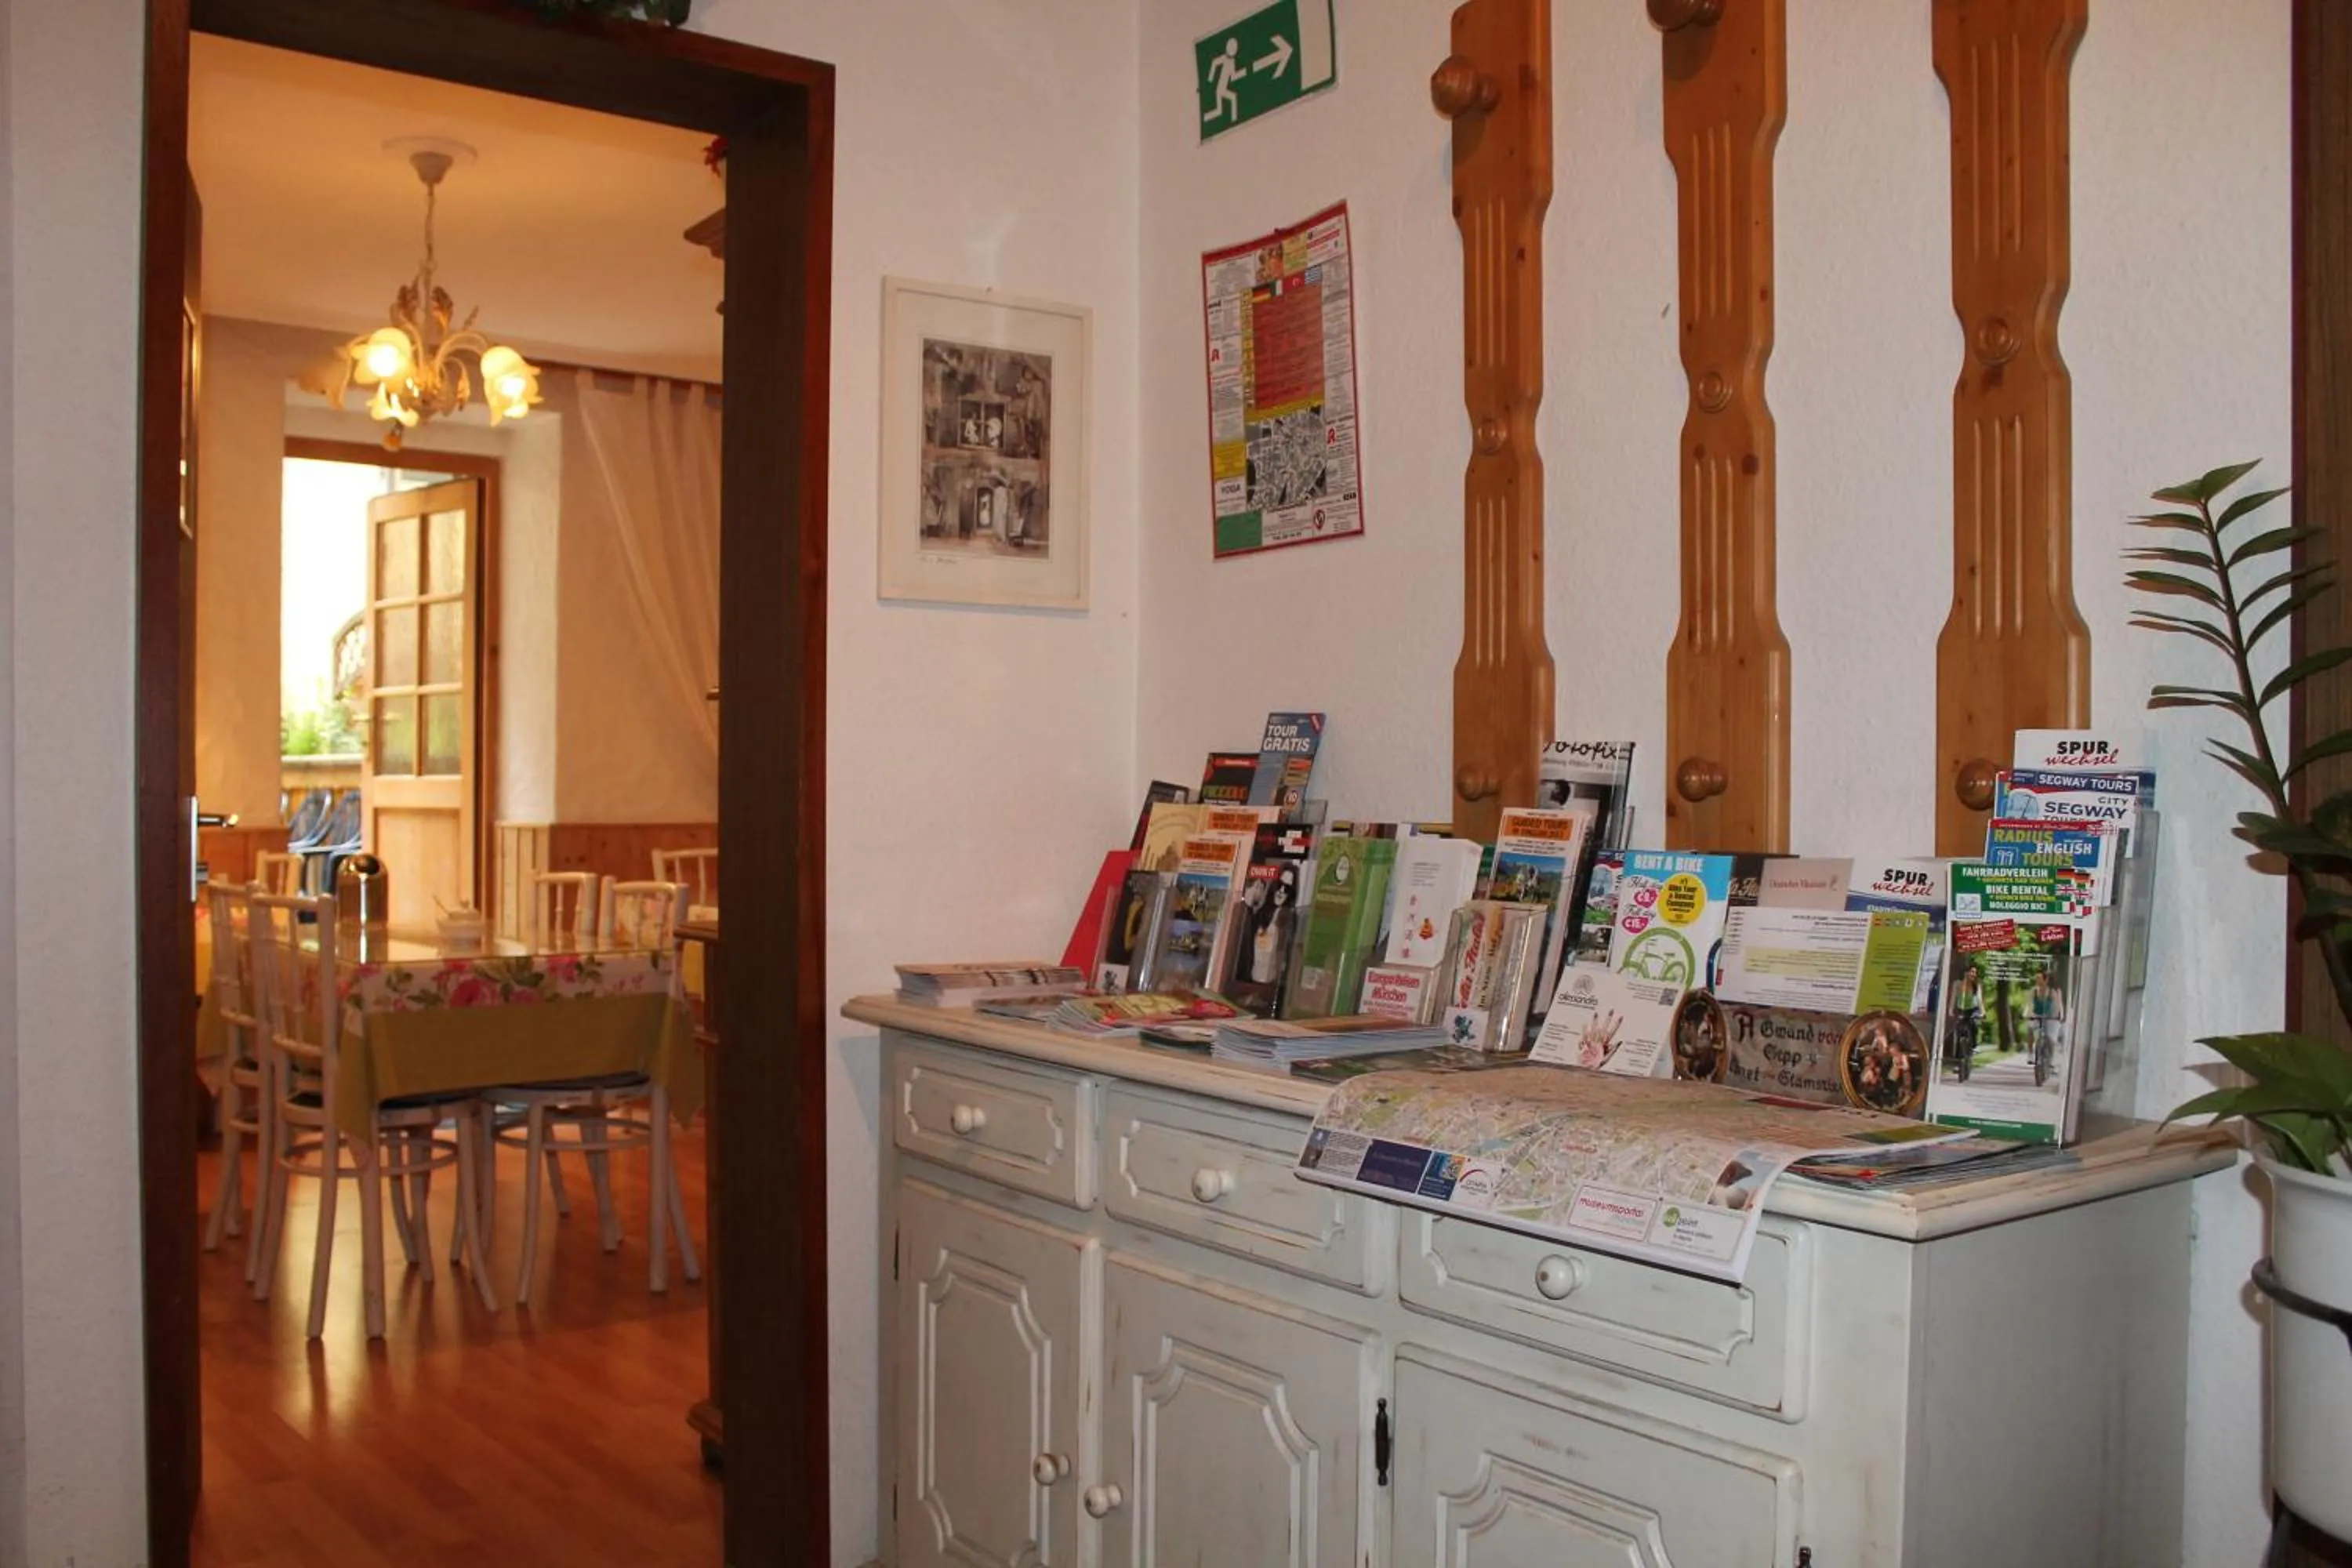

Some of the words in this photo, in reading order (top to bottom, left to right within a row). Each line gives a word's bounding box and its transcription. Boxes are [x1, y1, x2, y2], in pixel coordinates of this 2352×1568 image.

[1268, 725, 1298, 737] TOUR
[1263, 738, 1310, 752] GRATIS
[2057, 741, 2109, 755] SPUR
[2045, 748, 2118, 766] wechsel
[2038, 774, 2088, 788] SEGWAY
[2091, 779, 2132, 792] TOURS
[2097, 797, 2129, 806] CITY
[2044, 801, 2128, 819] SEGWAY
[1994, 829, 2053, 844] RADIUS
[2037, 843, 2092, 855] ENGLISH
[1634, 854, 1661, 869] RENT
[1664, 856, 1673, 871] A
[1675, 856, 1704, 873] BIKE
[2022, 852, 2074, 866] TOURS
[1883, 869, 1928, 884] SPUR
[1962, 867, 2049, 877] FAHRRADVERLEIH
[1871, 878, 1935, 896] wechsel
[1985, 884, 2010, 895] BIKE
[2011, 885, 2048, 895] RENTAL
[1989, 901, 2029, 910] NOLEGGIO
[1557, 991, 1599, 1006] alessandro
[1579, 1196, 1644, 1218] museumsportal
